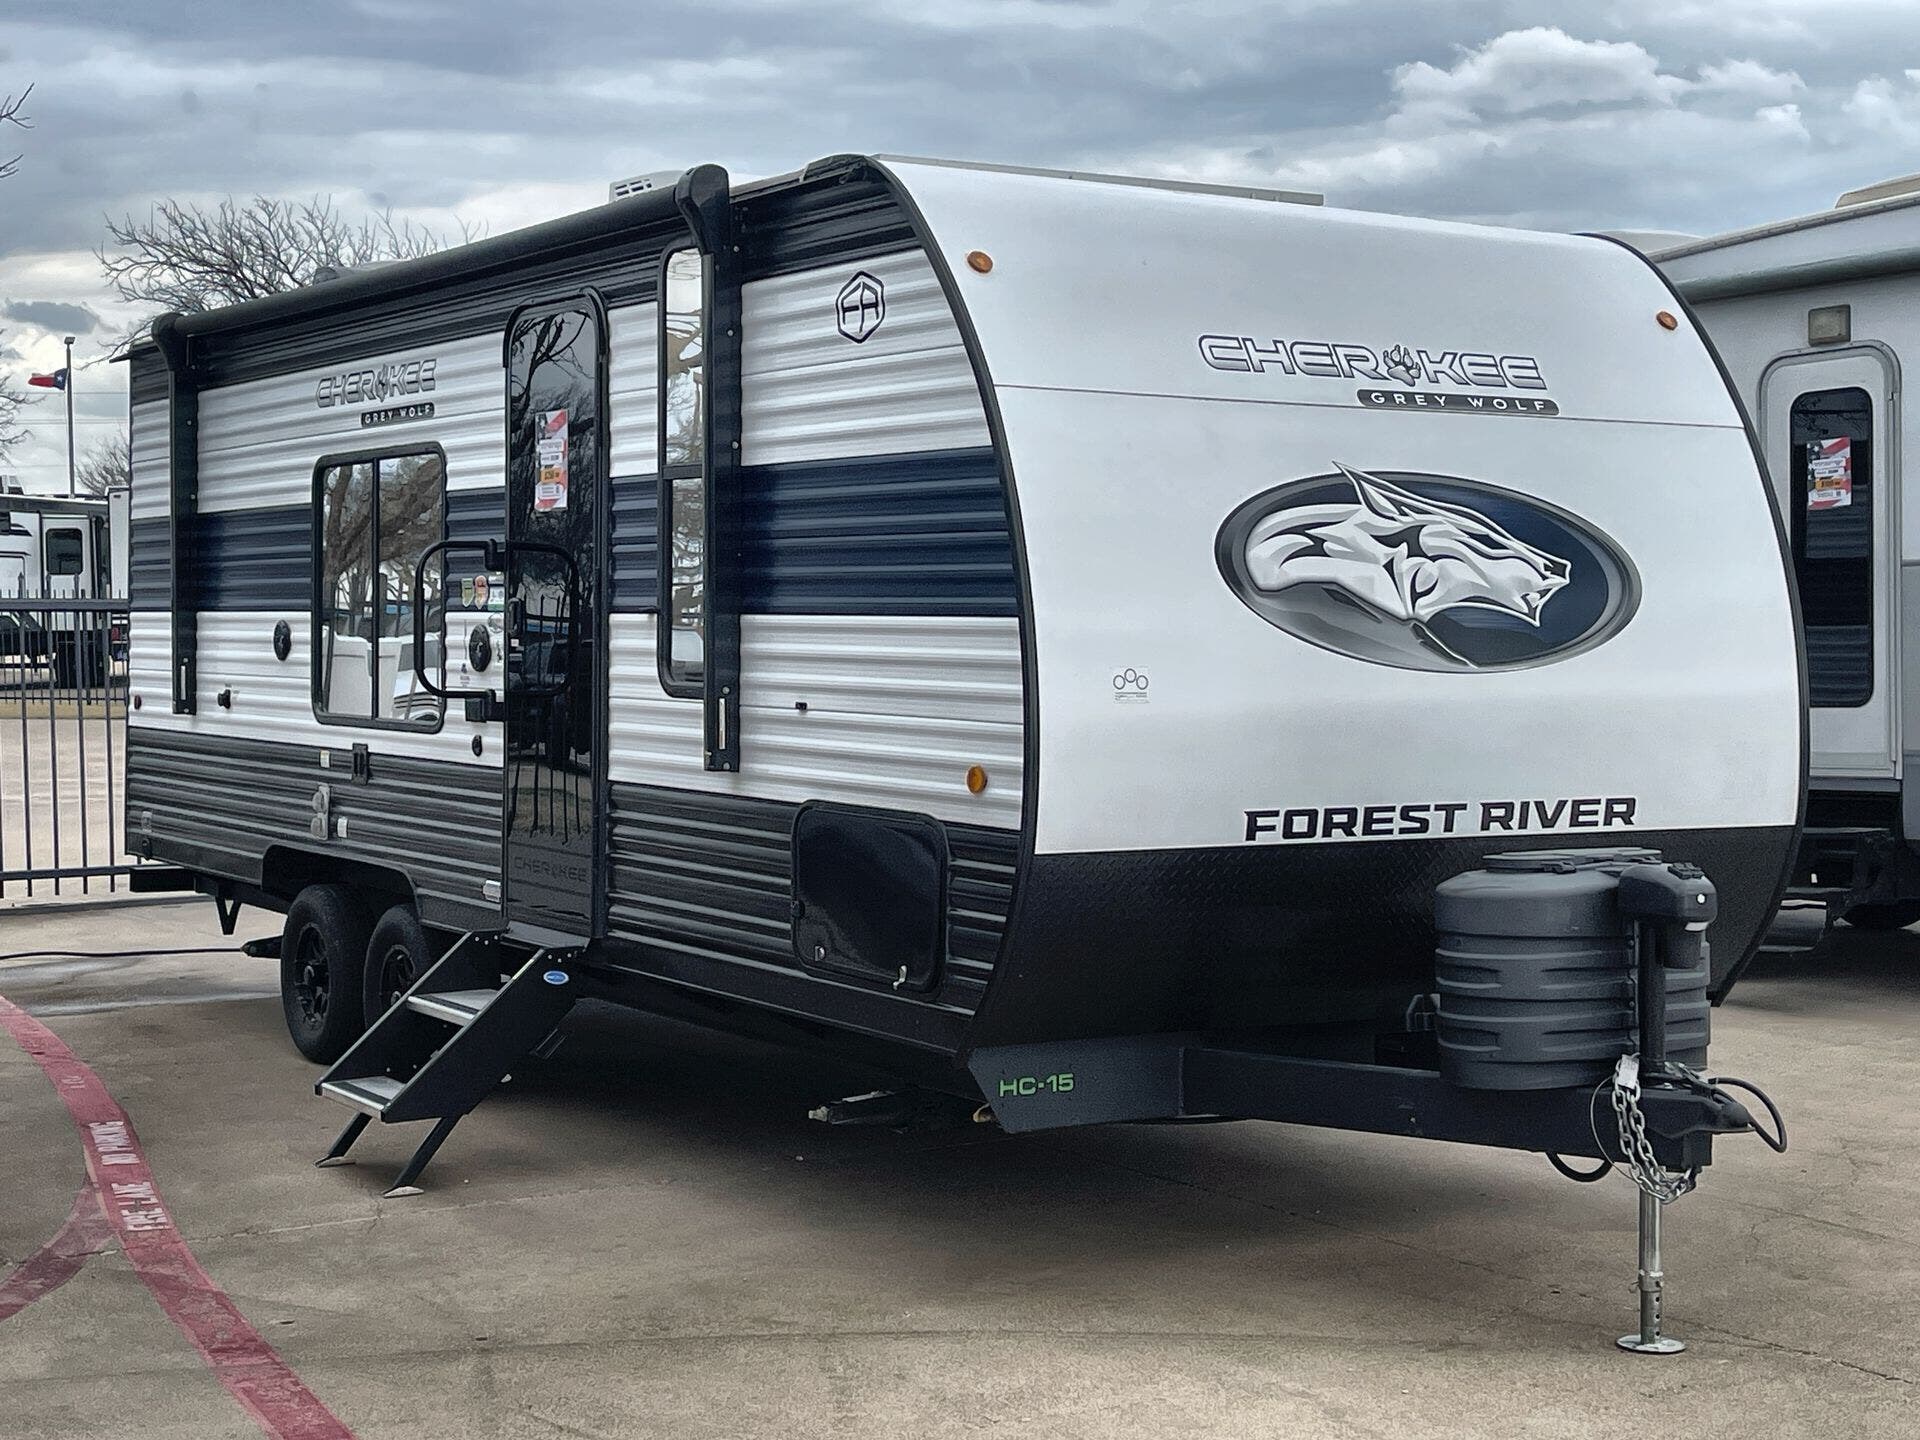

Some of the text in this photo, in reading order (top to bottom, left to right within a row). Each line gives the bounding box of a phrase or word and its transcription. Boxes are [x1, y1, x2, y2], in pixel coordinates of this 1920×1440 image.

[1198, 334, 1547, 391] CHEROKEE
[364, 404, 432, 424] GREY WOLF
[1369, 392, 1546, 412] GREY WOLF
[1243, 797, 1638, 842] FOREST RIVER
[999, 1072, 1075, 1097] HC-15
